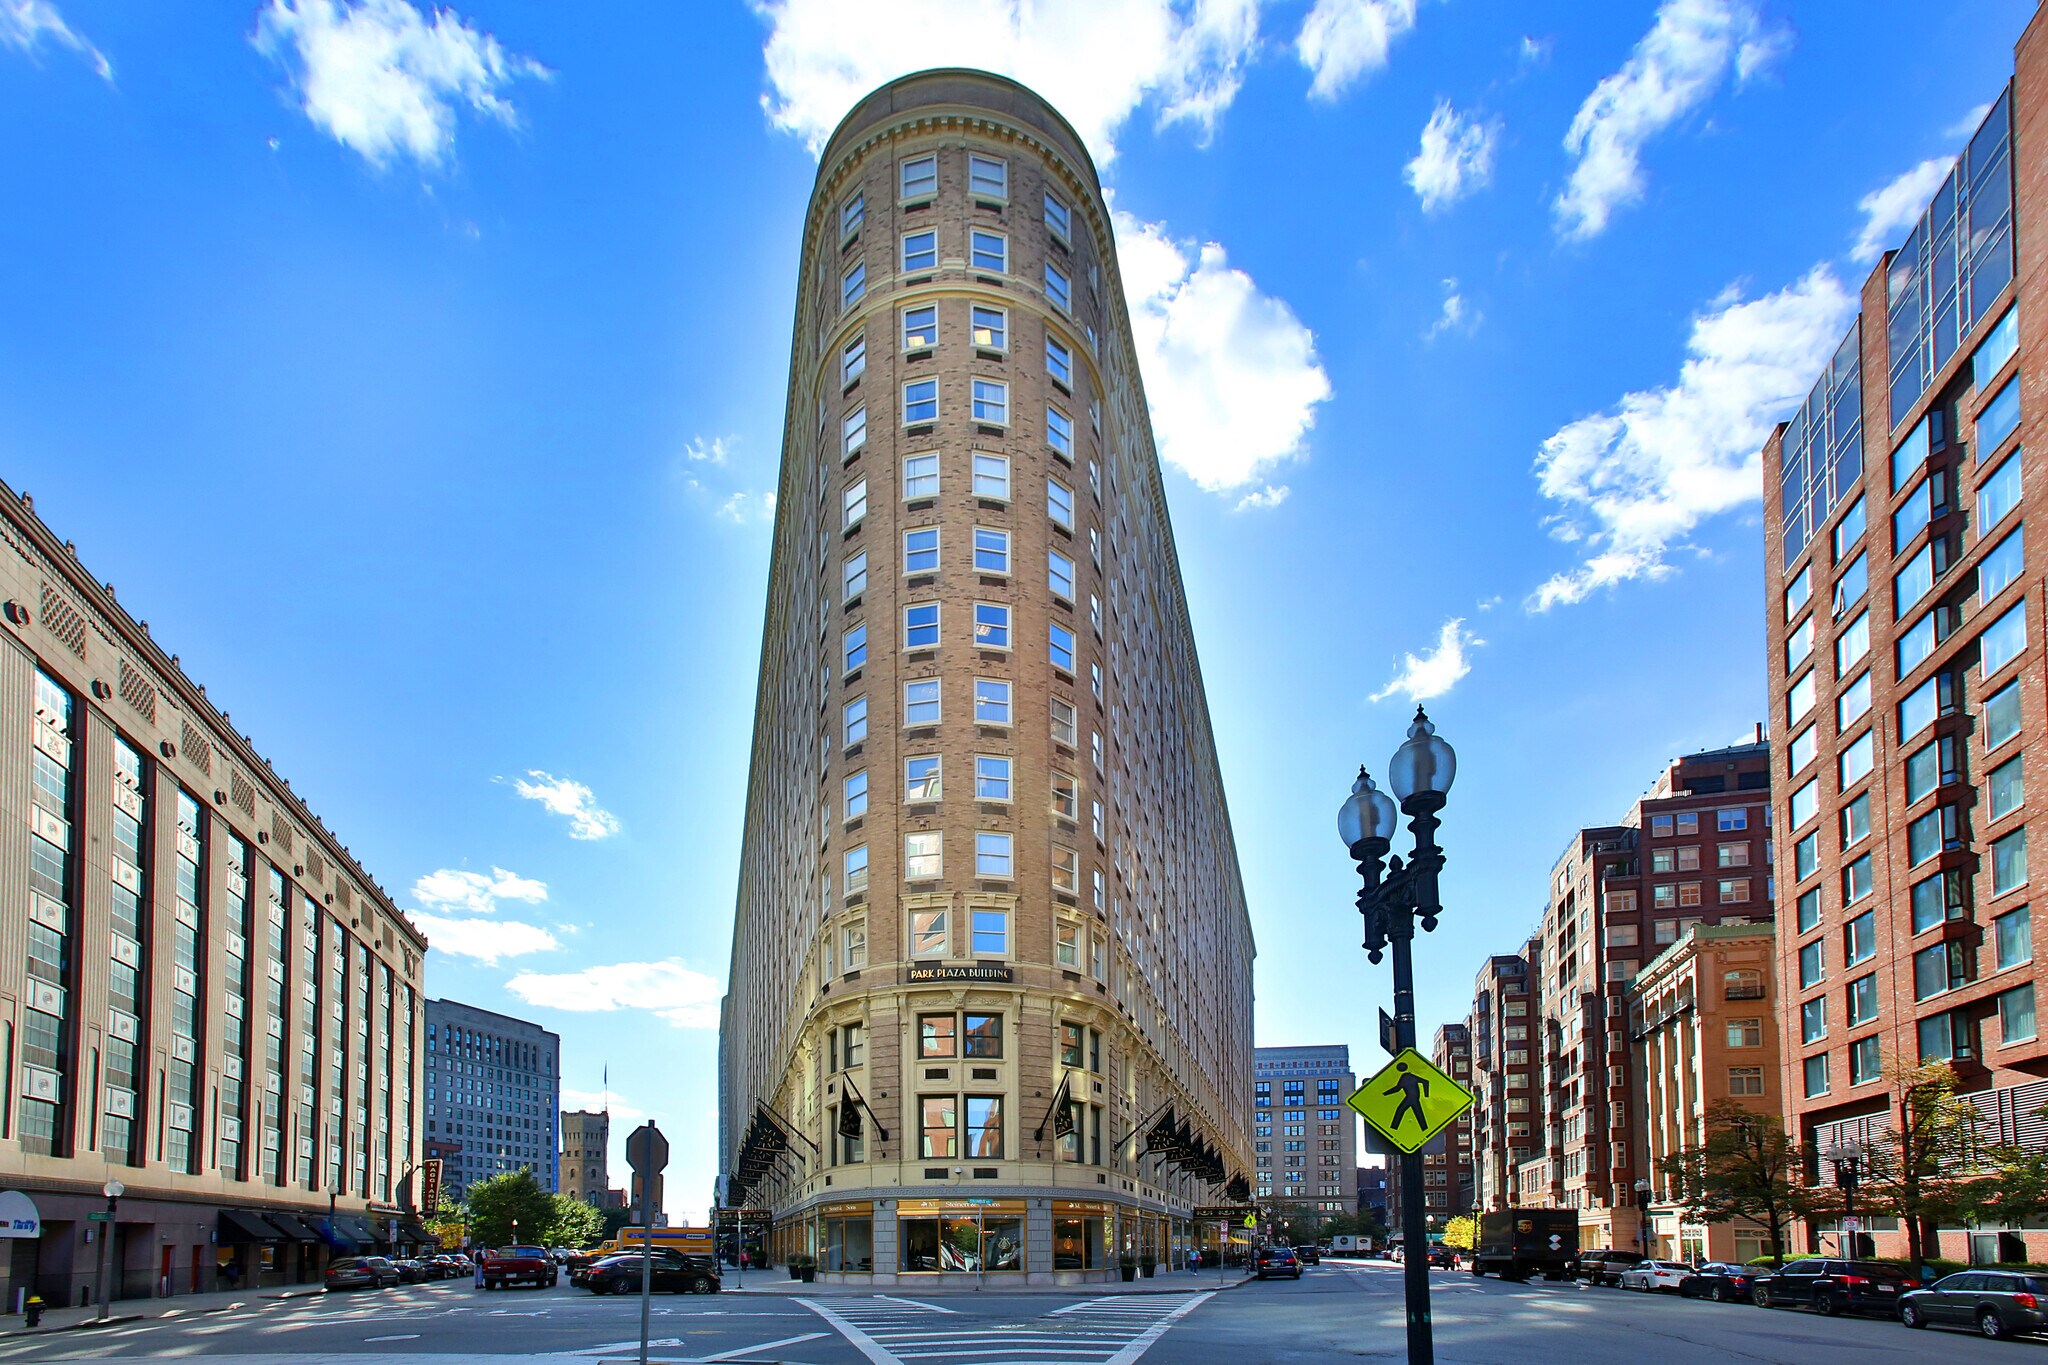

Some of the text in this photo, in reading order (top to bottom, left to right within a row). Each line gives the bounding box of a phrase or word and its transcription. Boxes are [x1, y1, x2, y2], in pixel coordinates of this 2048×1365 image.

[911, 968, 1008, 979] PARK PLAZA BUILDING
